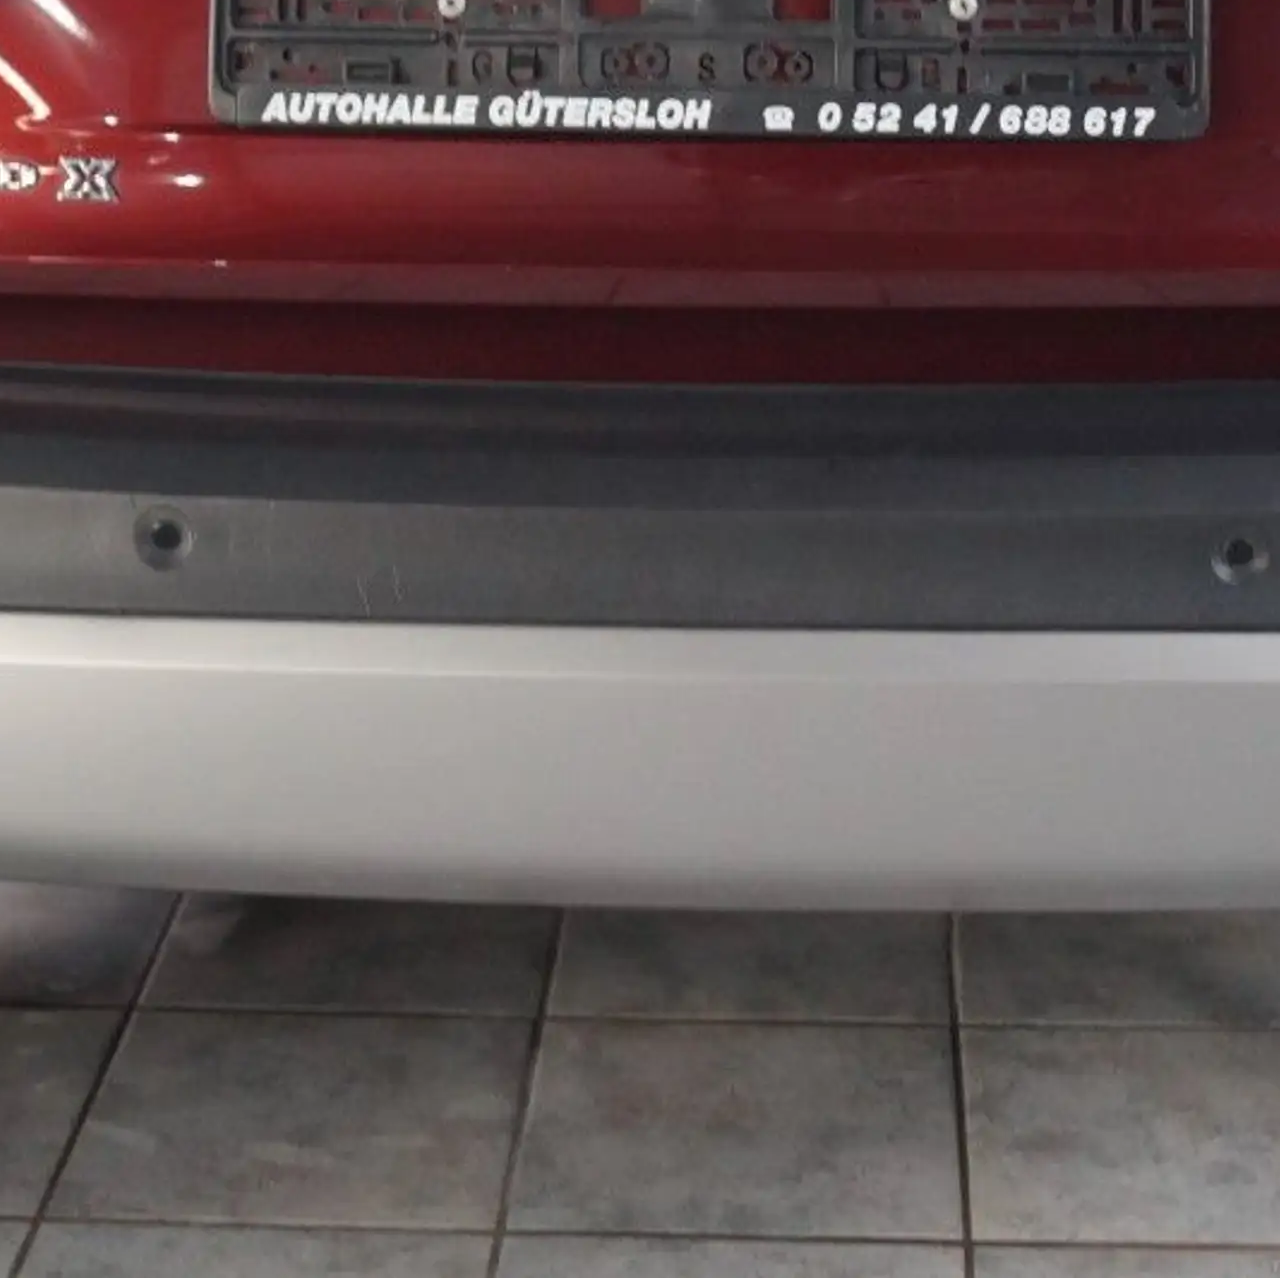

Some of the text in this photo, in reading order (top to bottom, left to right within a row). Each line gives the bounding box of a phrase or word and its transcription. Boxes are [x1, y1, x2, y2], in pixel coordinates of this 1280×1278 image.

[261, 92, 480, 125] AUTOHALLE
[488, 89, 712, 130] GÜTERSLOH
[818, 101, 842, 132] 0
[852, 101, 902, 133] 52
[913, 102, 958, 134] 41
[999, 104, 1072, 136] 688
[1083, 106, 1156, 138] 617
[57, 154, 120, 203] X
